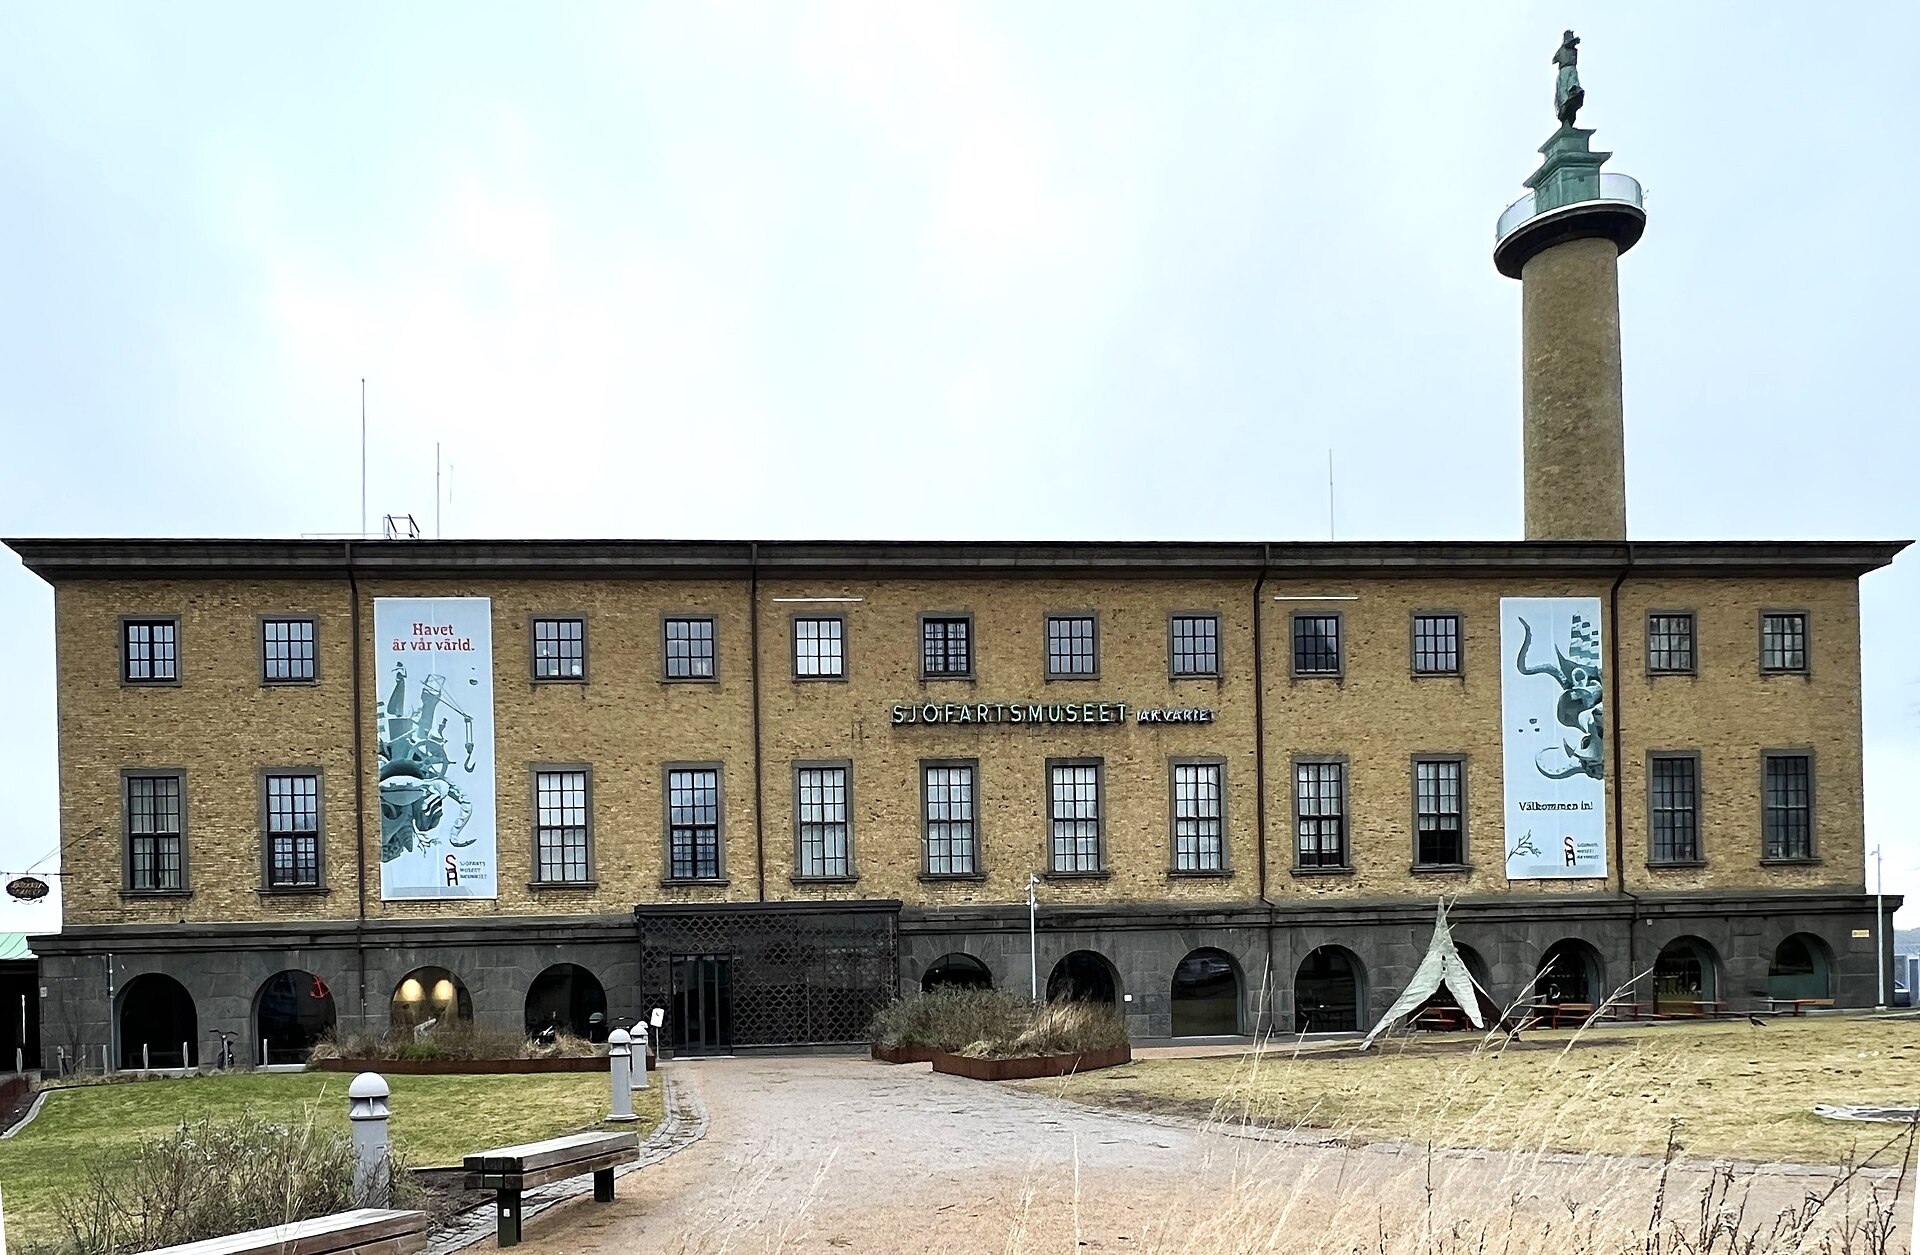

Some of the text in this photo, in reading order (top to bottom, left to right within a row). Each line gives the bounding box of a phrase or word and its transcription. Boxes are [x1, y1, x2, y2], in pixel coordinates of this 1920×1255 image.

[412, 622, 454, 636] Havet
[392, 637, 475, 651] är vår värld.
[1519, 800, 1593, 811] Välkommen in!
